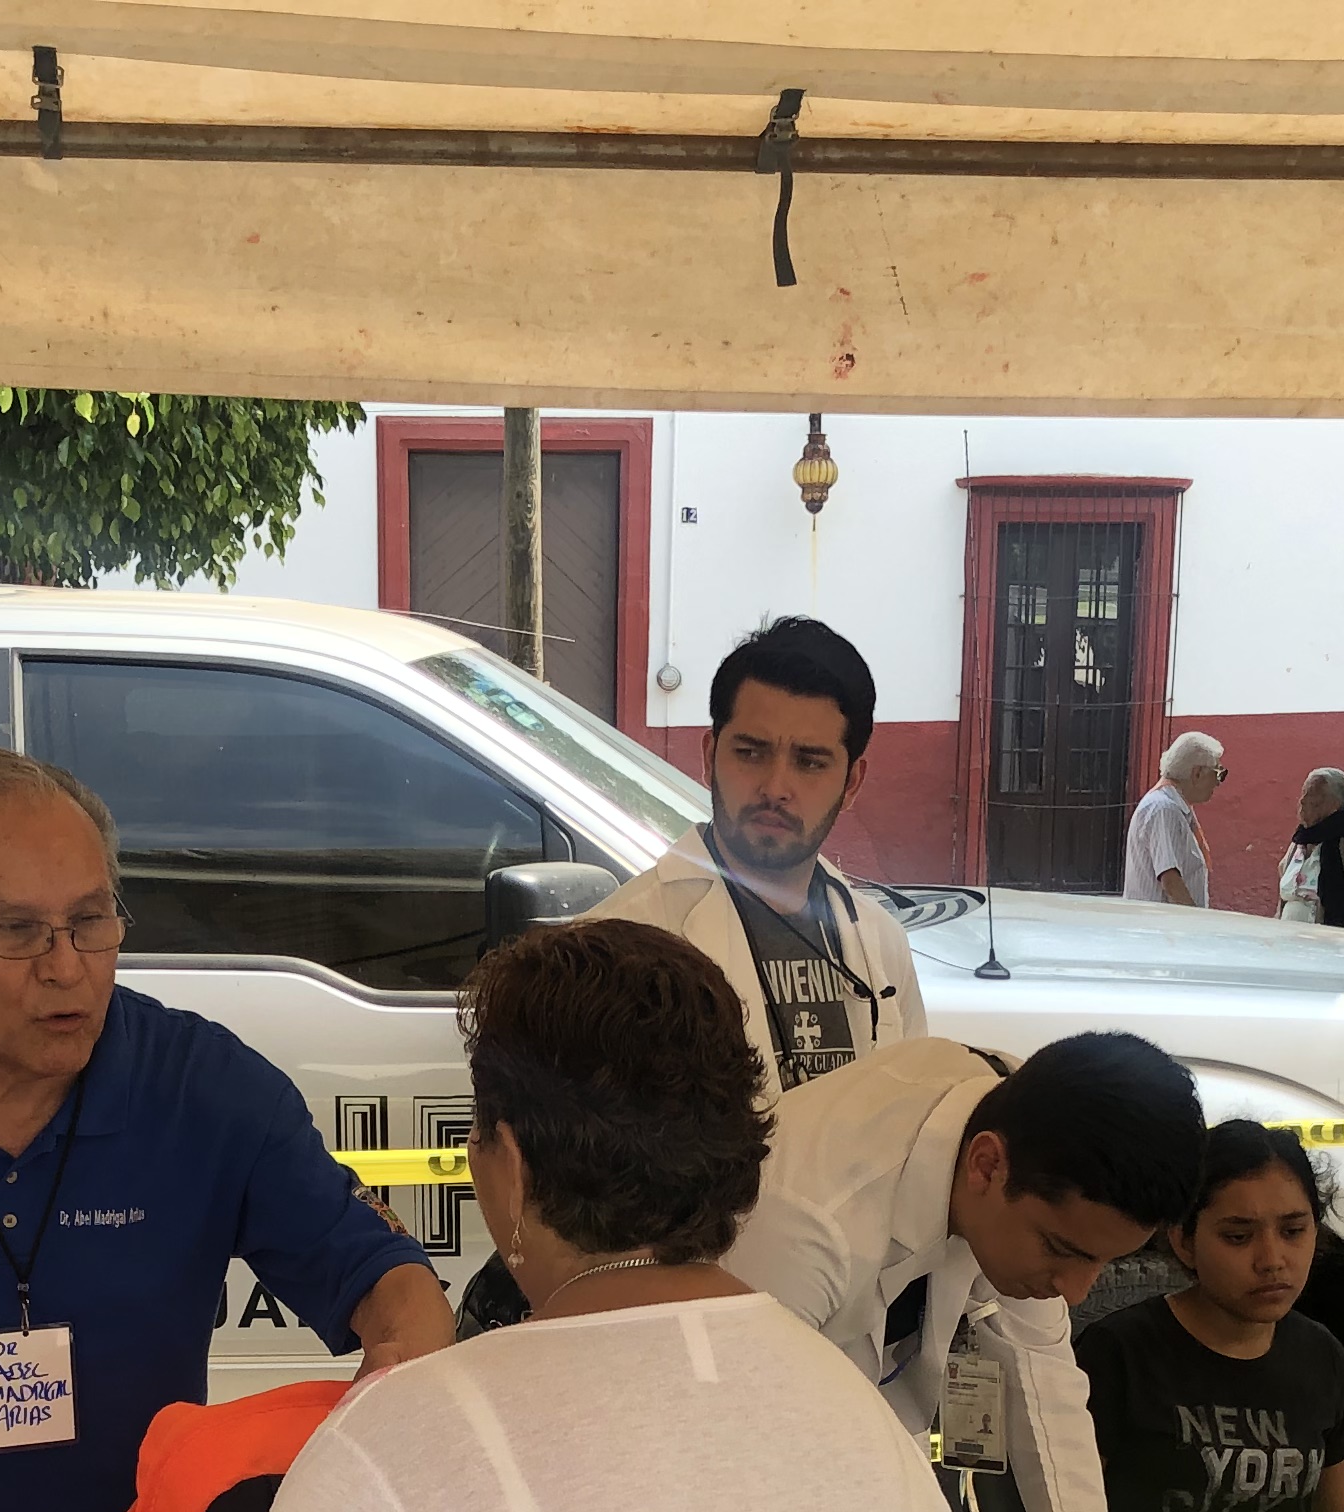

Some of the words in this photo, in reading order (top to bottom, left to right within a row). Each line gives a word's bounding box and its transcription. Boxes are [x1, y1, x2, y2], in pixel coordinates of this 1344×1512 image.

[682, 508, 697, 521] 12
[74, 1209, 92, 1226] Abel
[94, 1209, 127, 1228] Madrigal
[1175, 1404, 1290, 1447] NEW
